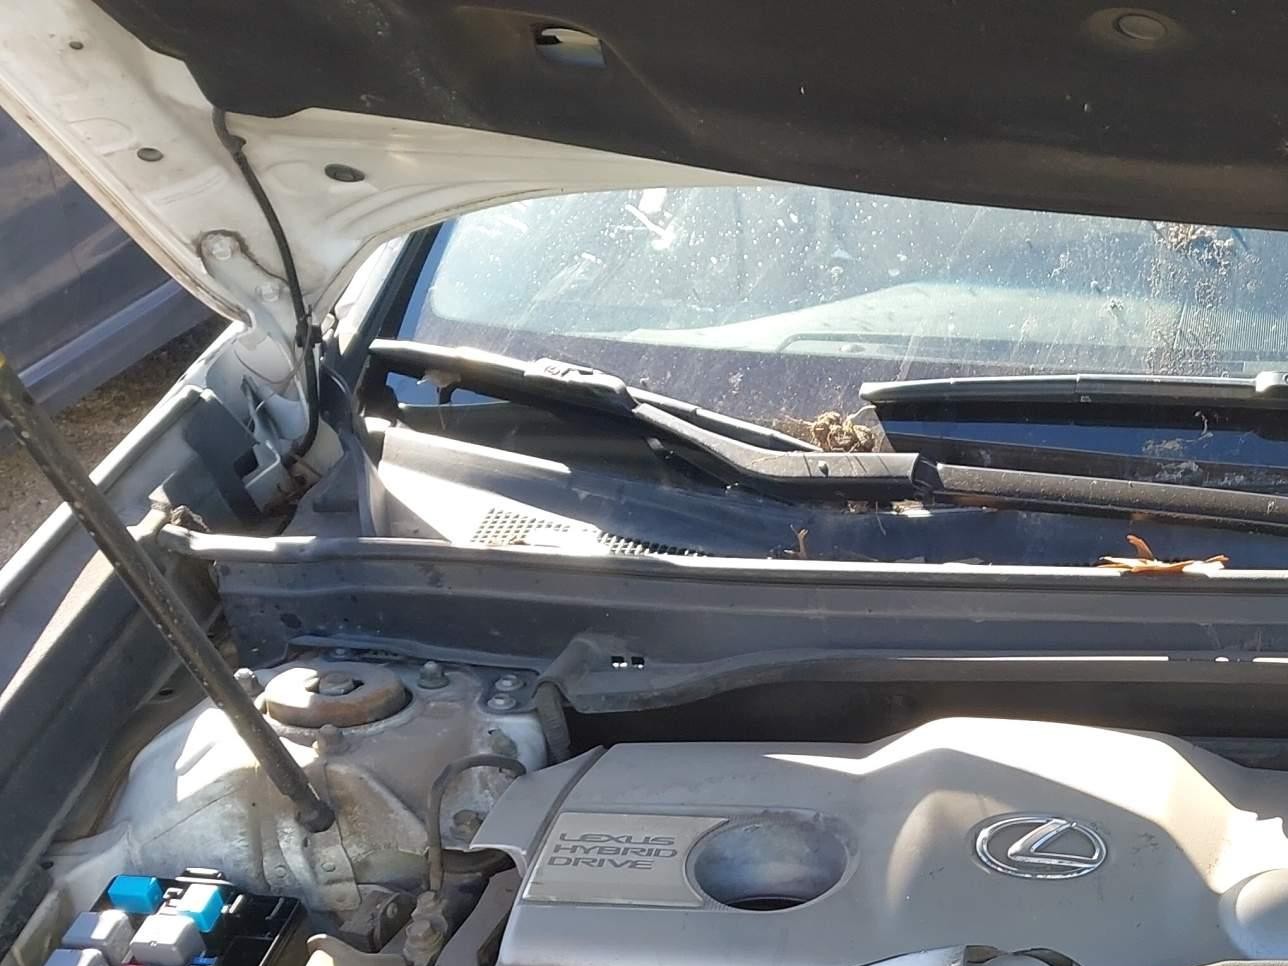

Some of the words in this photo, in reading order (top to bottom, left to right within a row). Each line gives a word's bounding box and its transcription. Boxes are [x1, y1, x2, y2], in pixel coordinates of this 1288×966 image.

[559, 832, 676, 846] LEXUS
[553, 844, 678, 858] HYBRID
[547, 855, 655, 870] DRIVE
